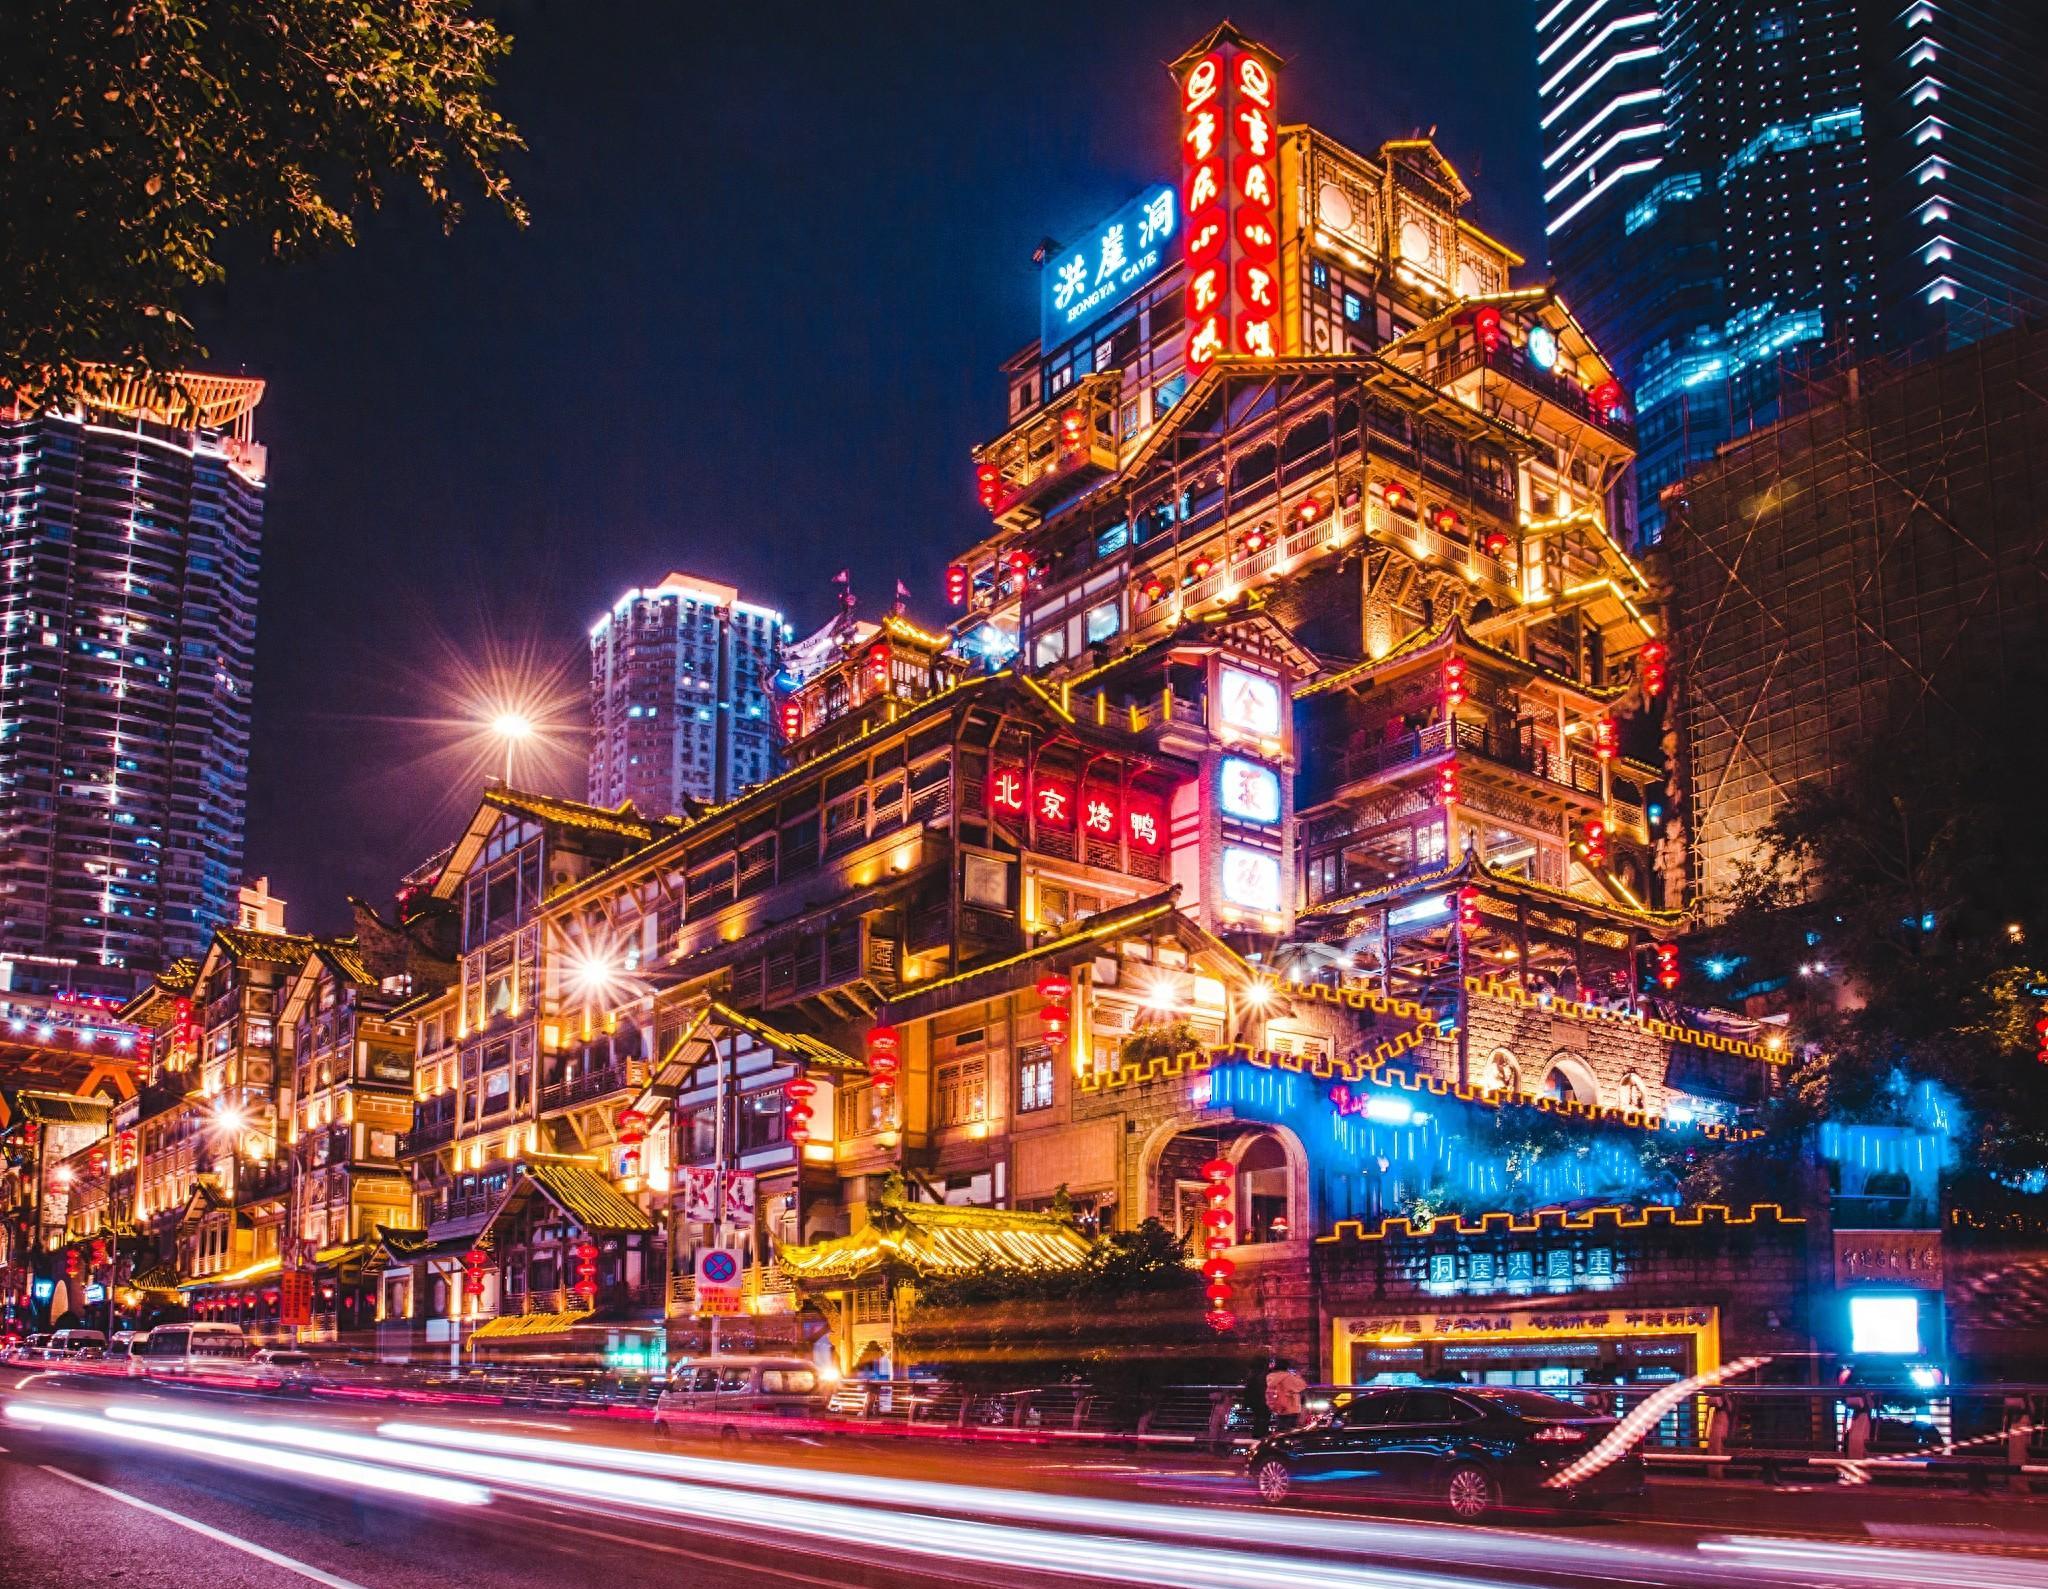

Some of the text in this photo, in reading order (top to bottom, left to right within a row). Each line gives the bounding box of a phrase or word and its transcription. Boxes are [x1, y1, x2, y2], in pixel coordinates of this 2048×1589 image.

[1053, 190, 1173, 309] 洪崖洞
[1067, 250, 1157, 323] HONGYA CAVE
[994, 774, 1158, 846] 北京烤鸭
